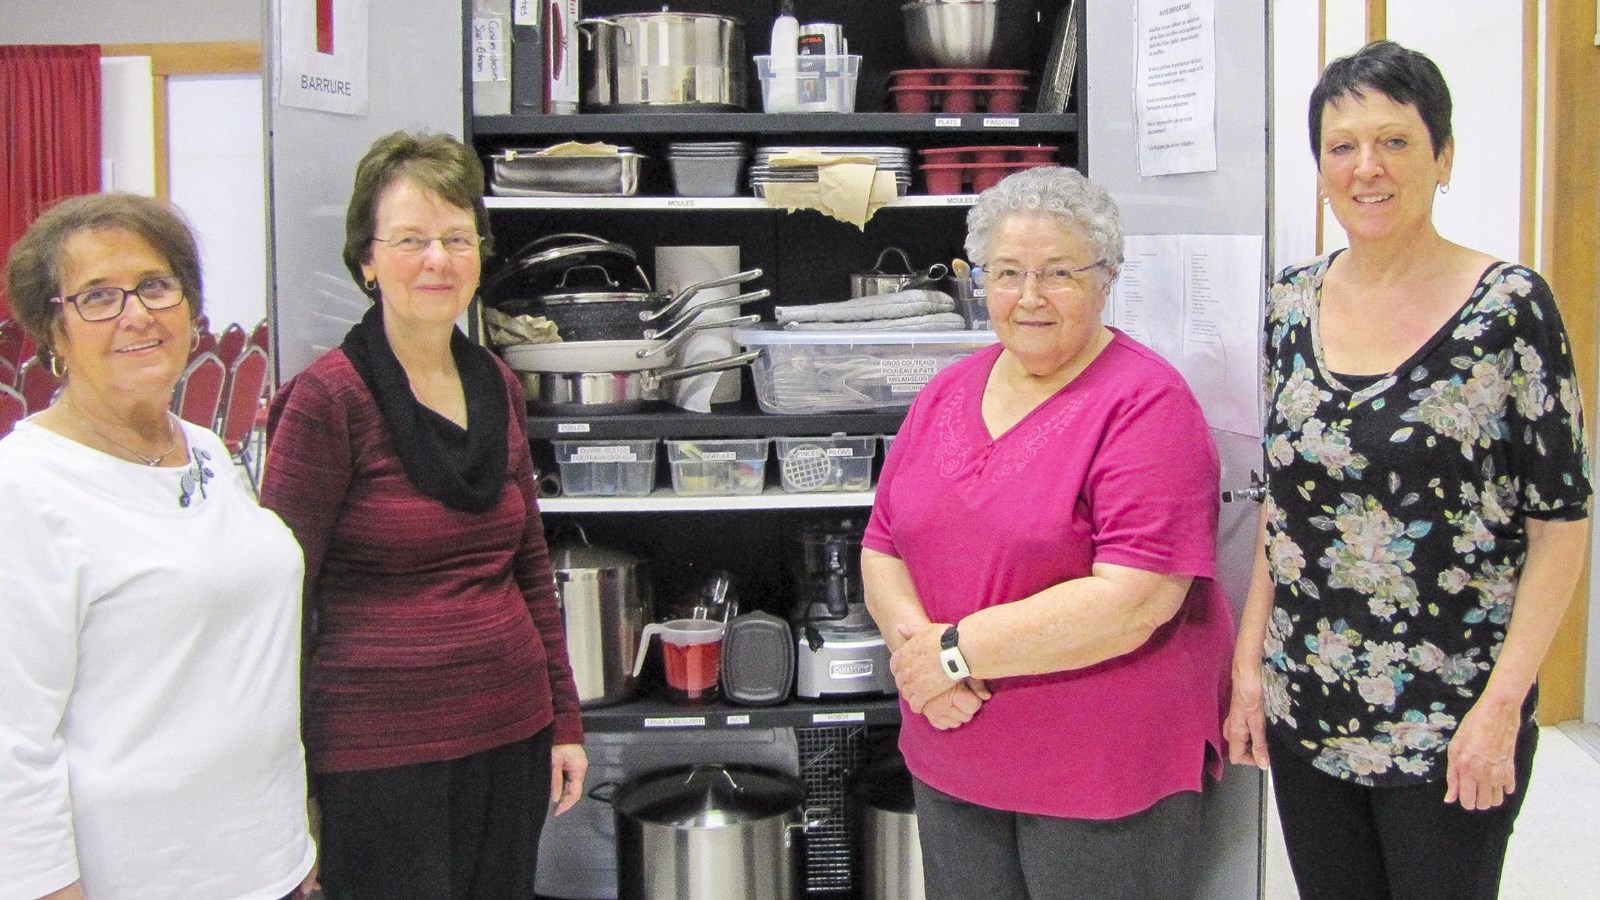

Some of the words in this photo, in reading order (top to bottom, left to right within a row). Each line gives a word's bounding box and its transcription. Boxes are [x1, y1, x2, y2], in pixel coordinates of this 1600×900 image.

[1159, 8, 1168, 16] AVIS
[1169, 2, 1192, 14] IMPORTANT
[301, 74, 351, 96] BARRURE
[668, 199, 695, 207] MOULES
